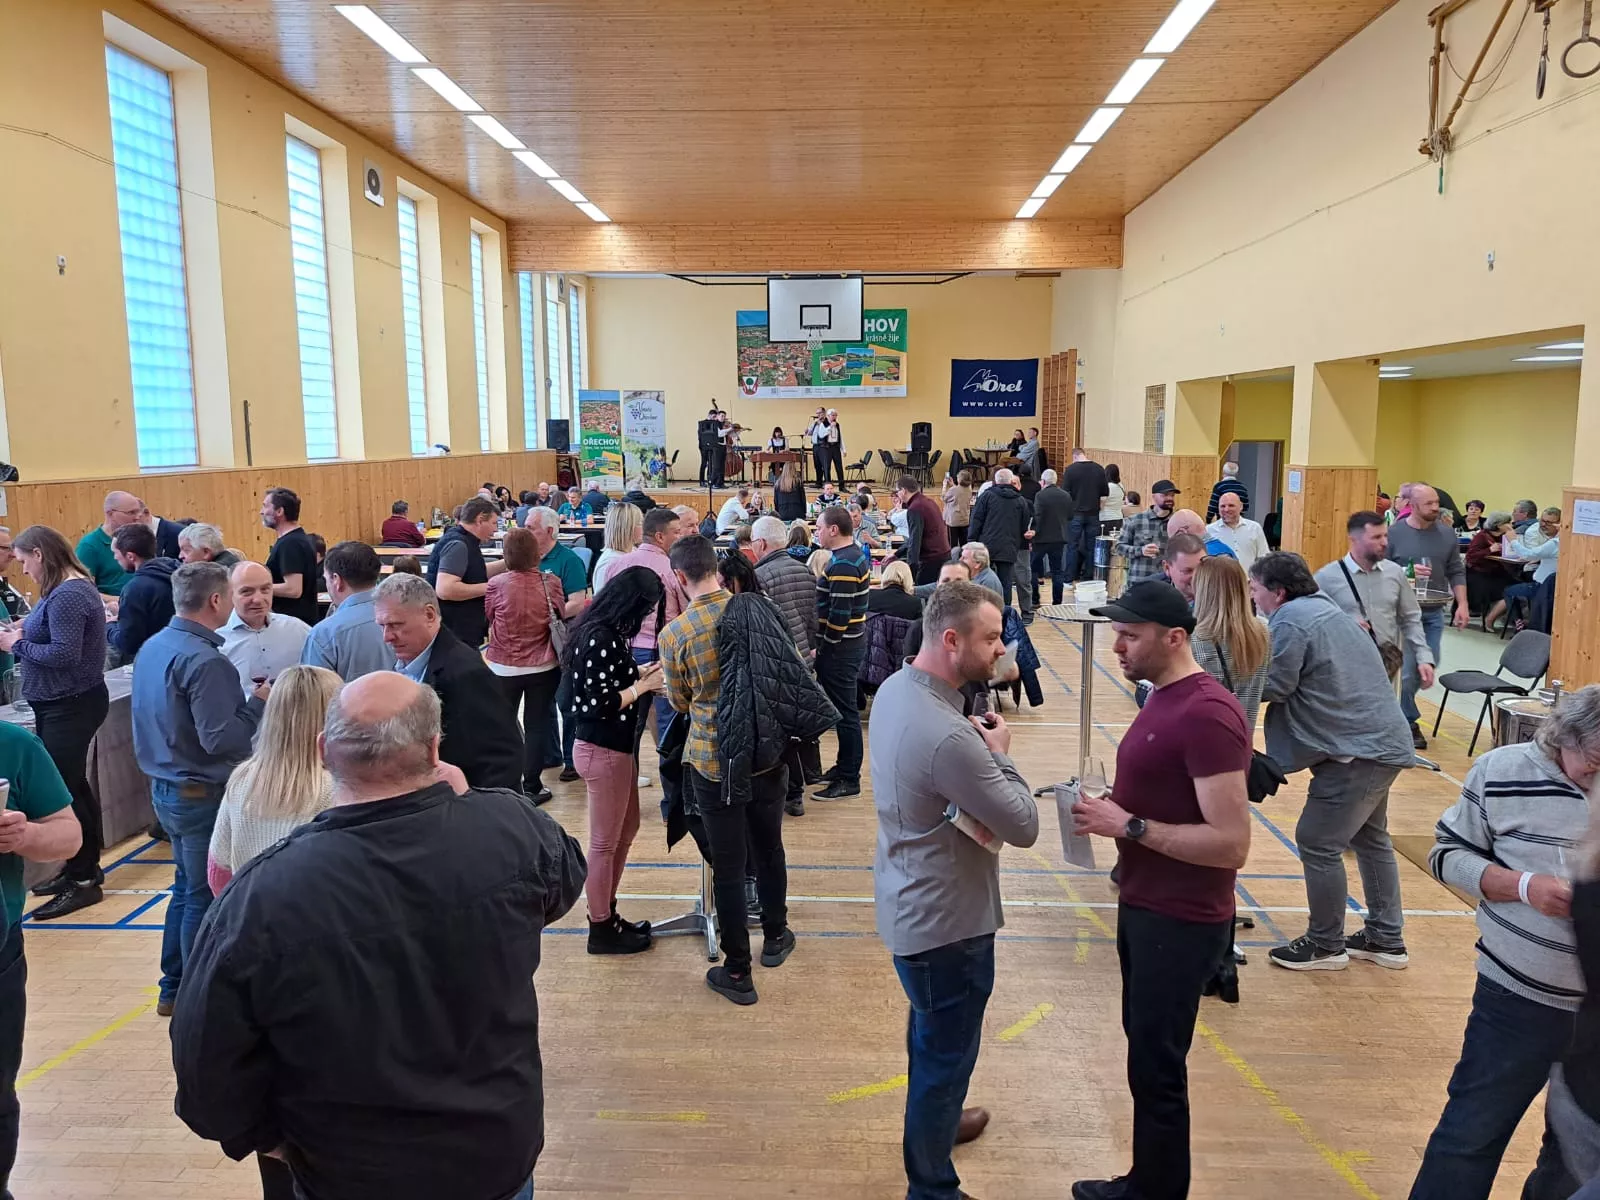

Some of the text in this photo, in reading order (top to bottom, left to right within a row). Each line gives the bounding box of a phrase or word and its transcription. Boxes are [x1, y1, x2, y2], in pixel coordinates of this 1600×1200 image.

[888, 333, 899, 343] žije
[984, 379, 1023, 392] Orel
[583, 437, 620, 445] OŘECHOV
